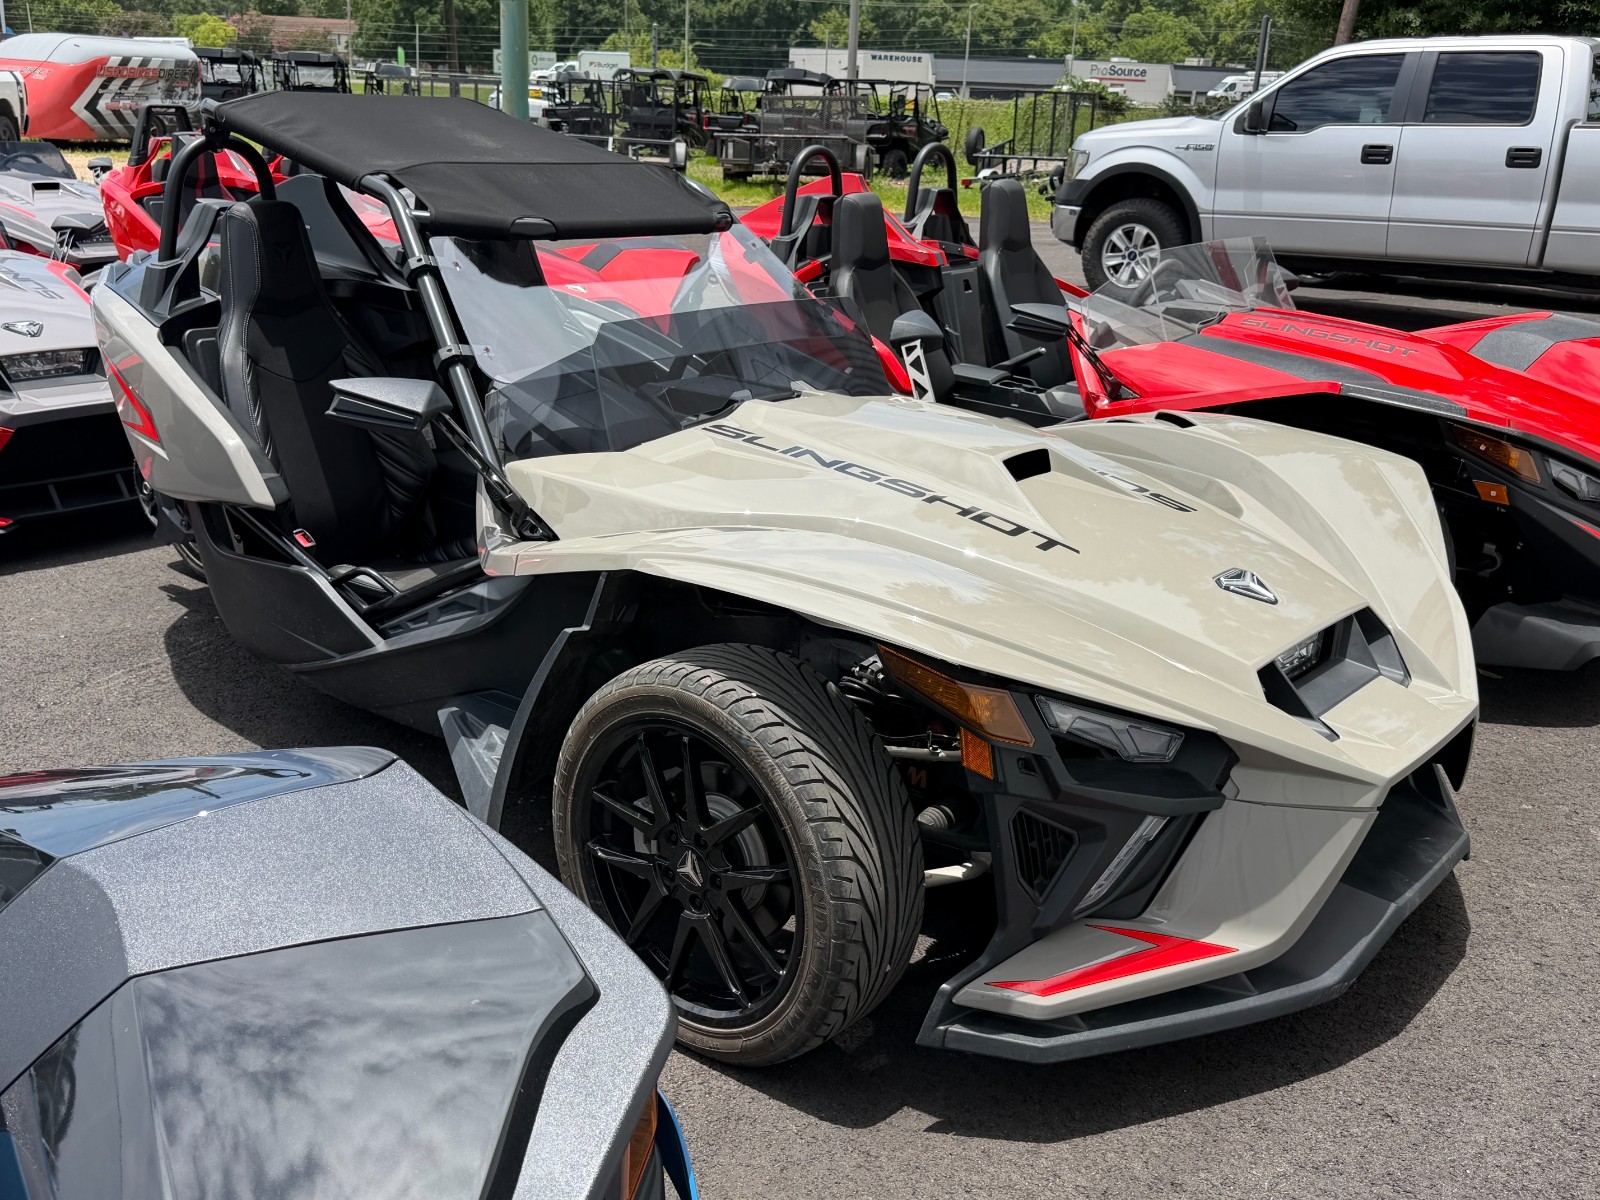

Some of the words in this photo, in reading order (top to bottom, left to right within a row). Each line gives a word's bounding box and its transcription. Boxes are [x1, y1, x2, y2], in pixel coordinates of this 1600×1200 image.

[597, 61, 619, 70] Budget
[871, 54, 923, 63] WAREHOUSE
[1090, 64, 1147, 78] ProSource
[1240, 318, 1419, 356] SLINGSHOT
[701, 424, 1080, 554] SLINGSHOT
[800, 843, 830, 950] KENDA
